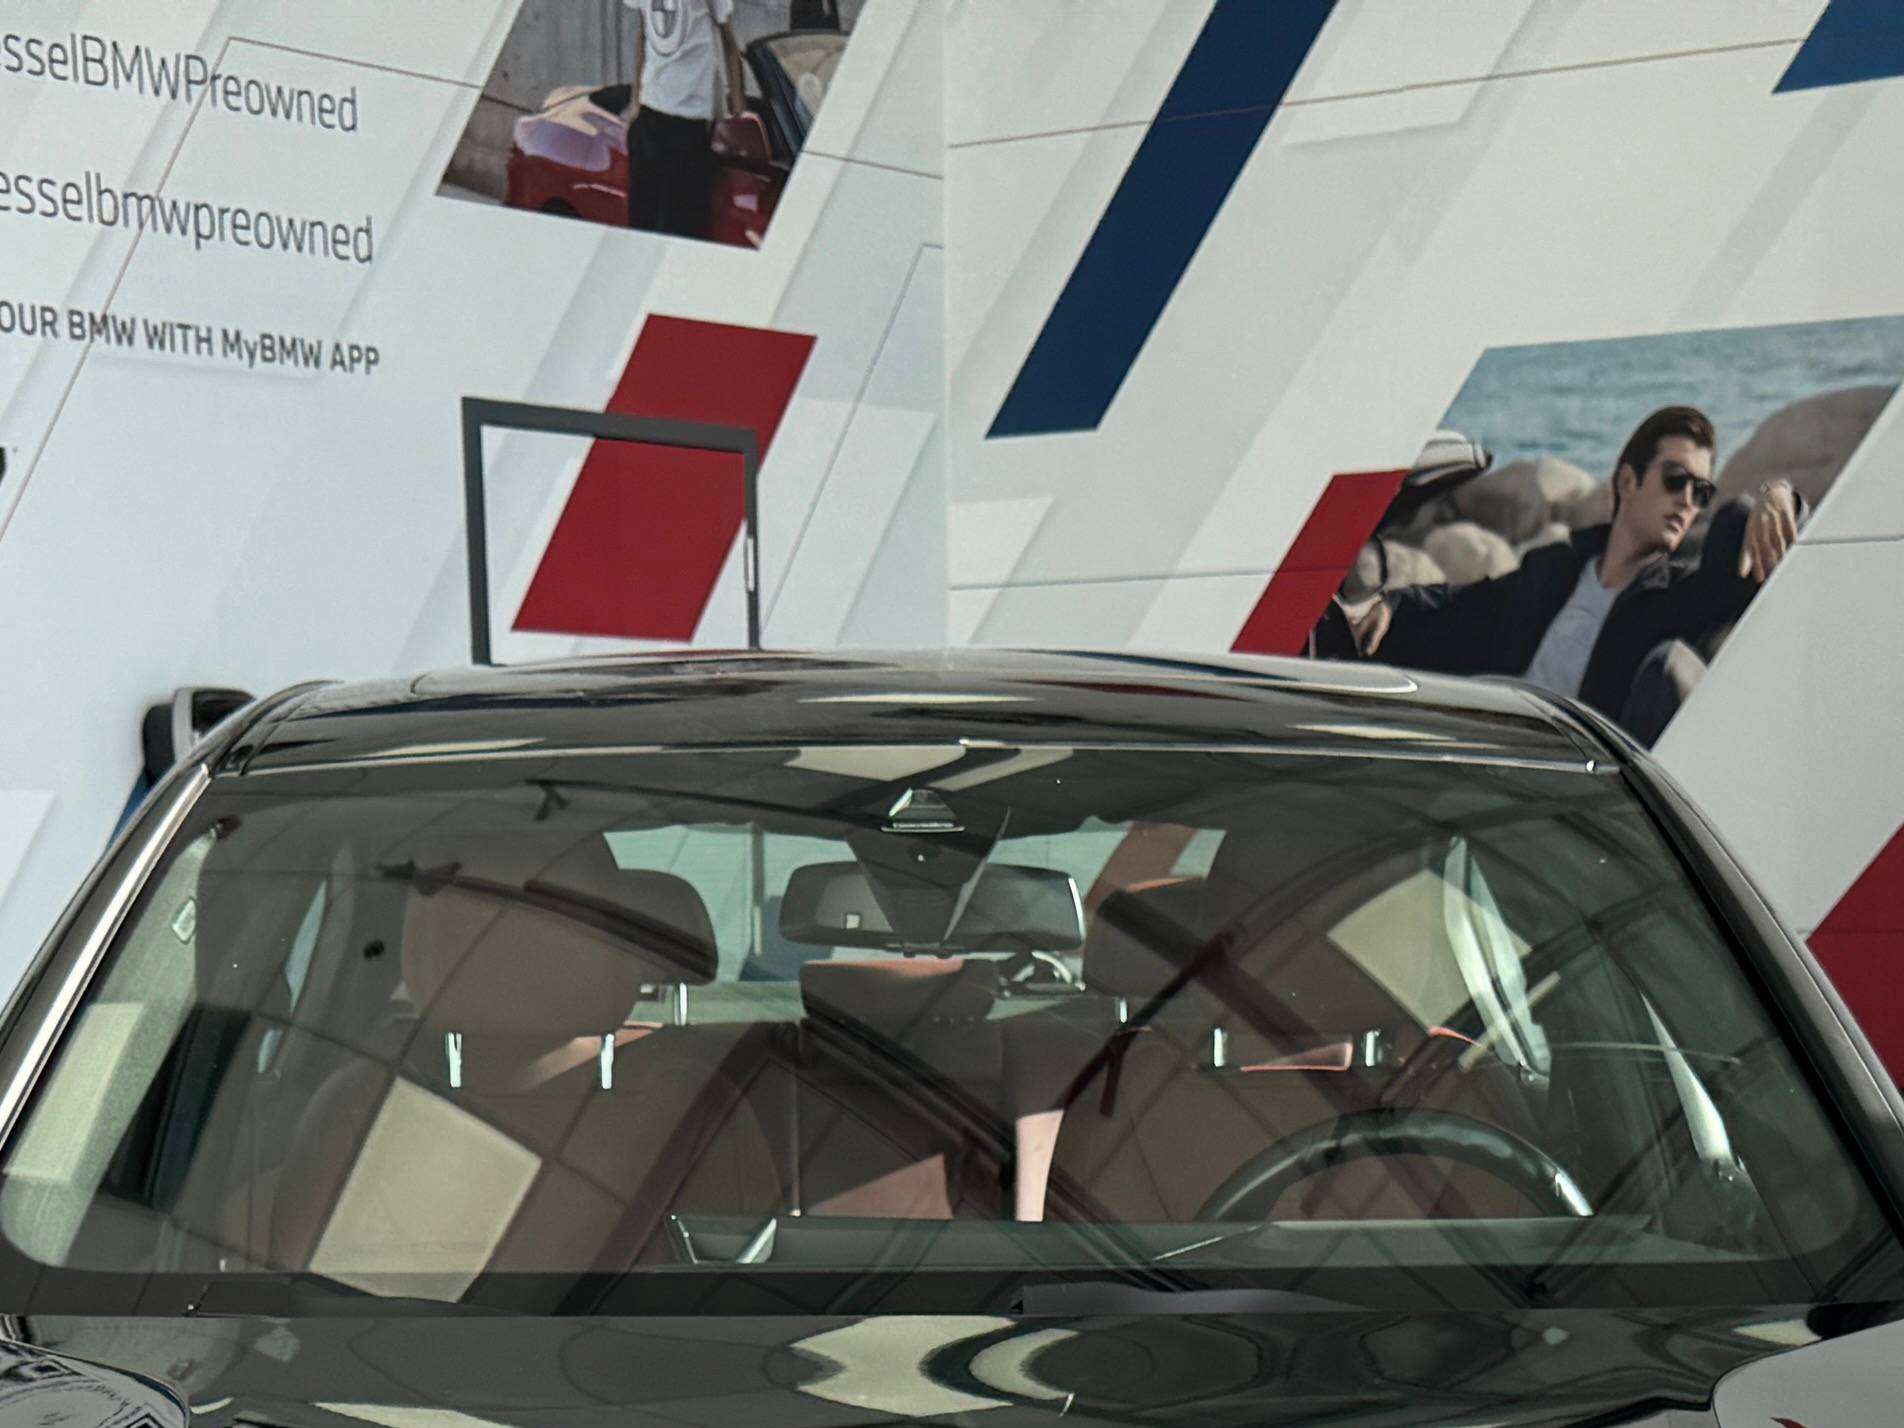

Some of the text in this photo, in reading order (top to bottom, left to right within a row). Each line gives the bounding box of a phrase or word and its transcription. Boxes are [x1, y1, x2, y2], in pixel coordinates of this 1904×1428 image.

[68, 309, 137, 348] BMW
[143, 320, 215, 358] WITH
[220, 327, 324, 370] MyBMW
[329, 341, 382, 376] APP
